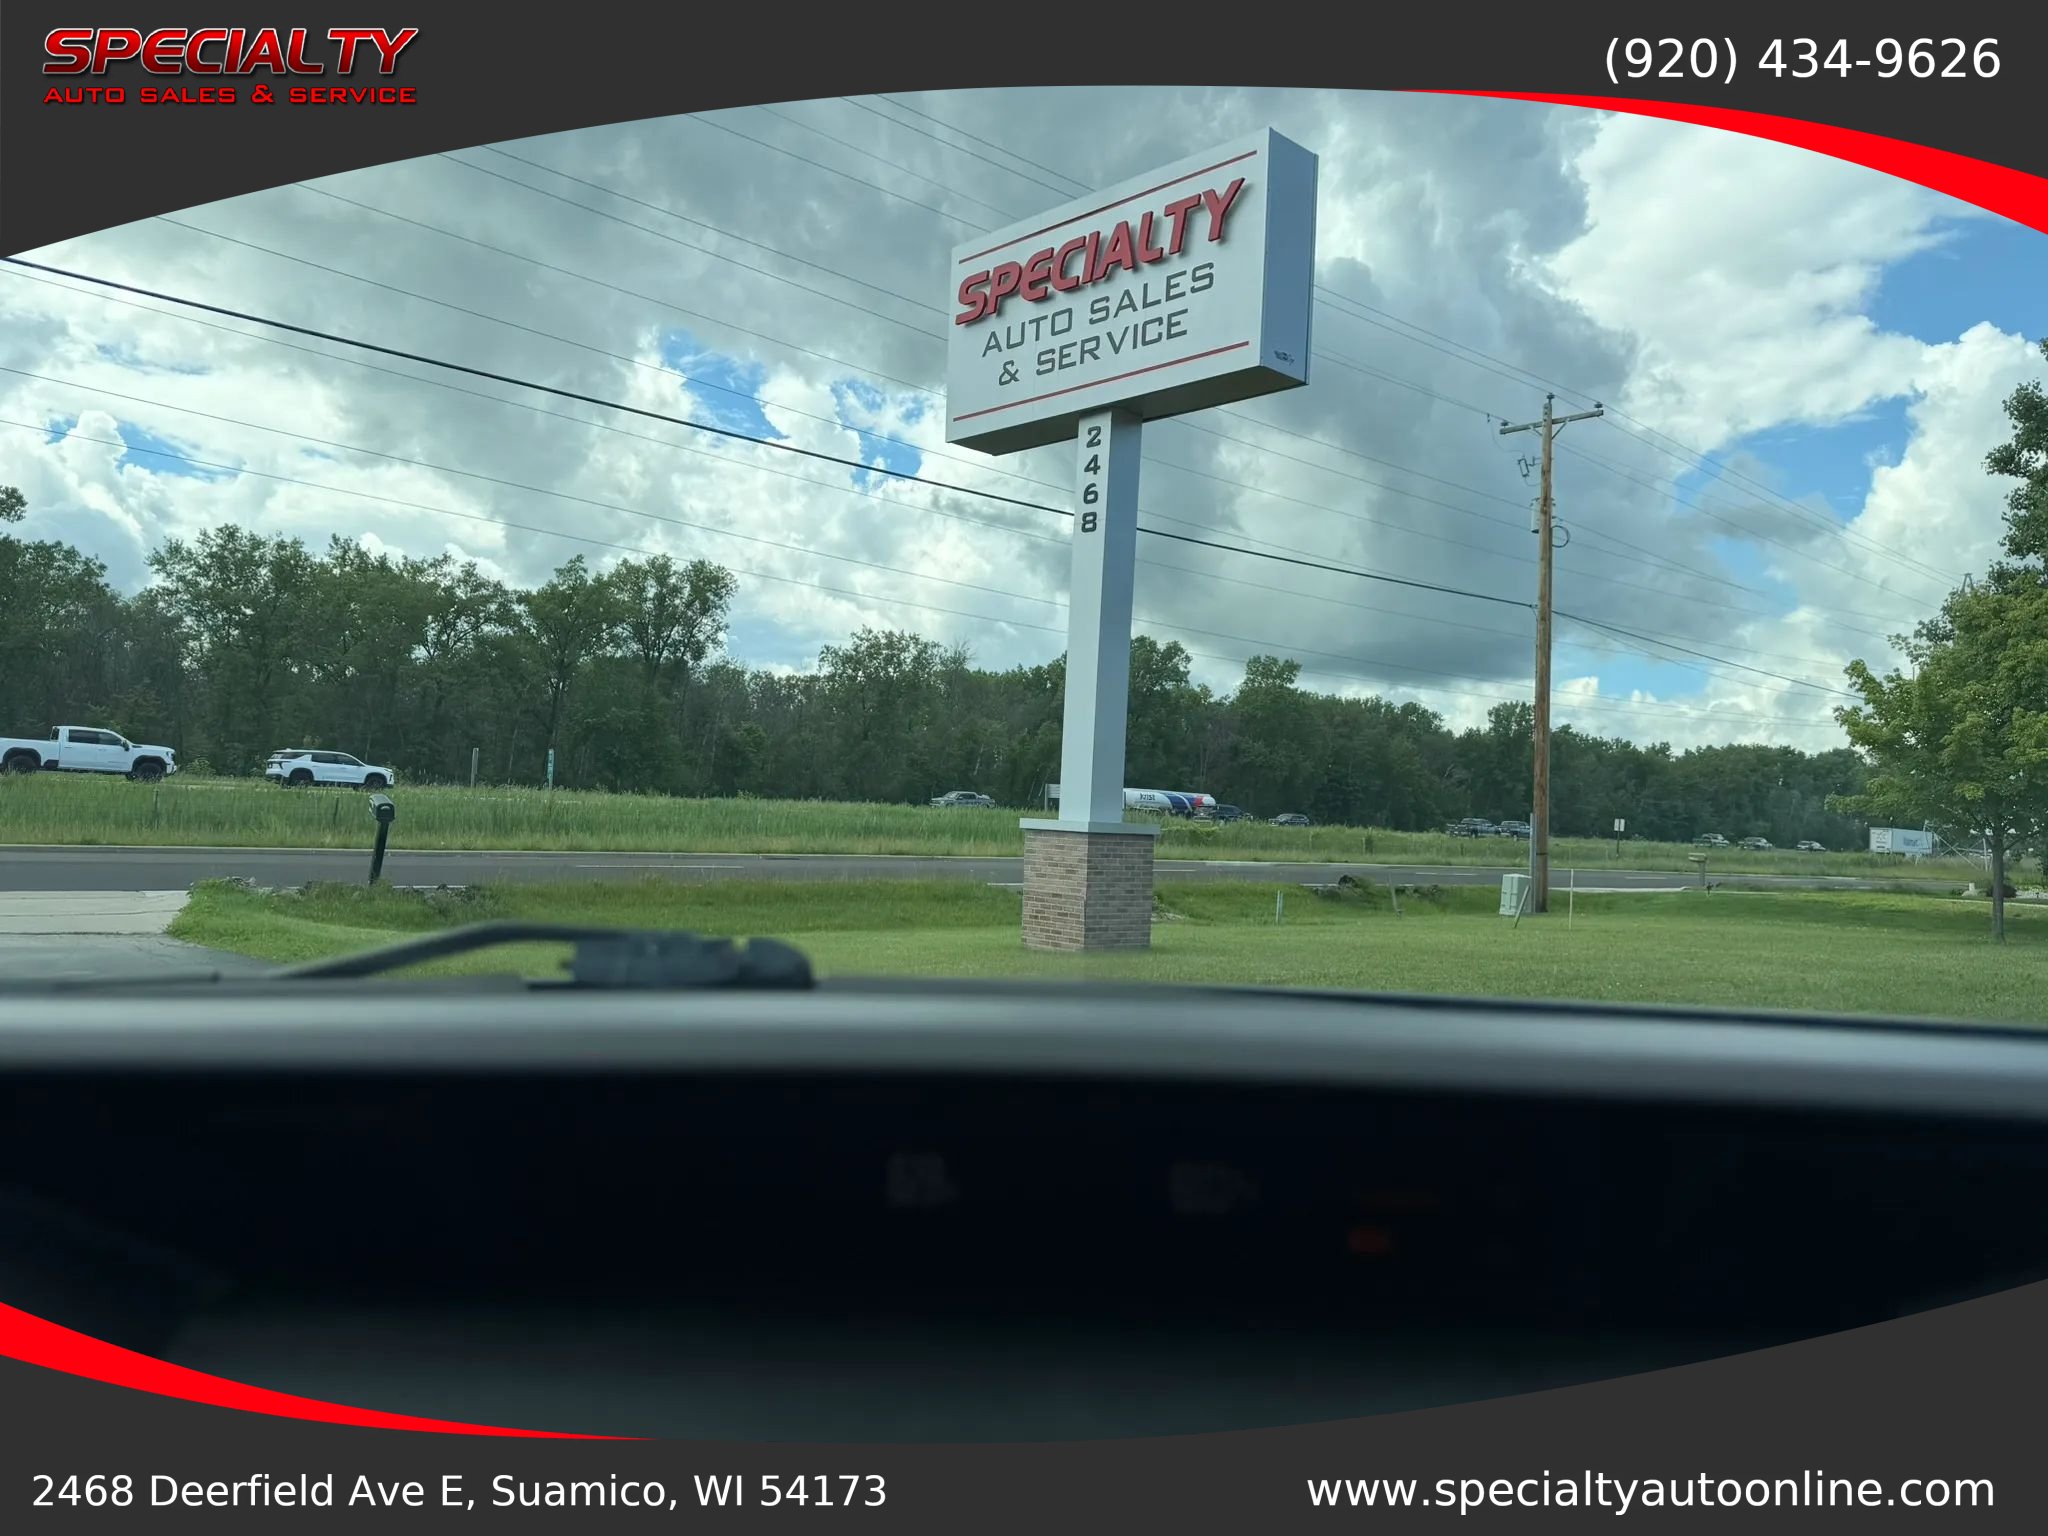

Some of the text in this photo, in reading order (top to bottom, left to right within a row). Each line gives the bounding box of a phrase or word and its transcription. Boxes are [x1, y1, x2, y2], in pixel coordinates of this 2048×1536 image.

[955, 177, 1246, 326] SPECIALTY
[982, 262, 1214, 357] AUTO SALES
[998, 308, 1188, 386] & SERVICE
[1081, 426, 1102, 533] 2468
